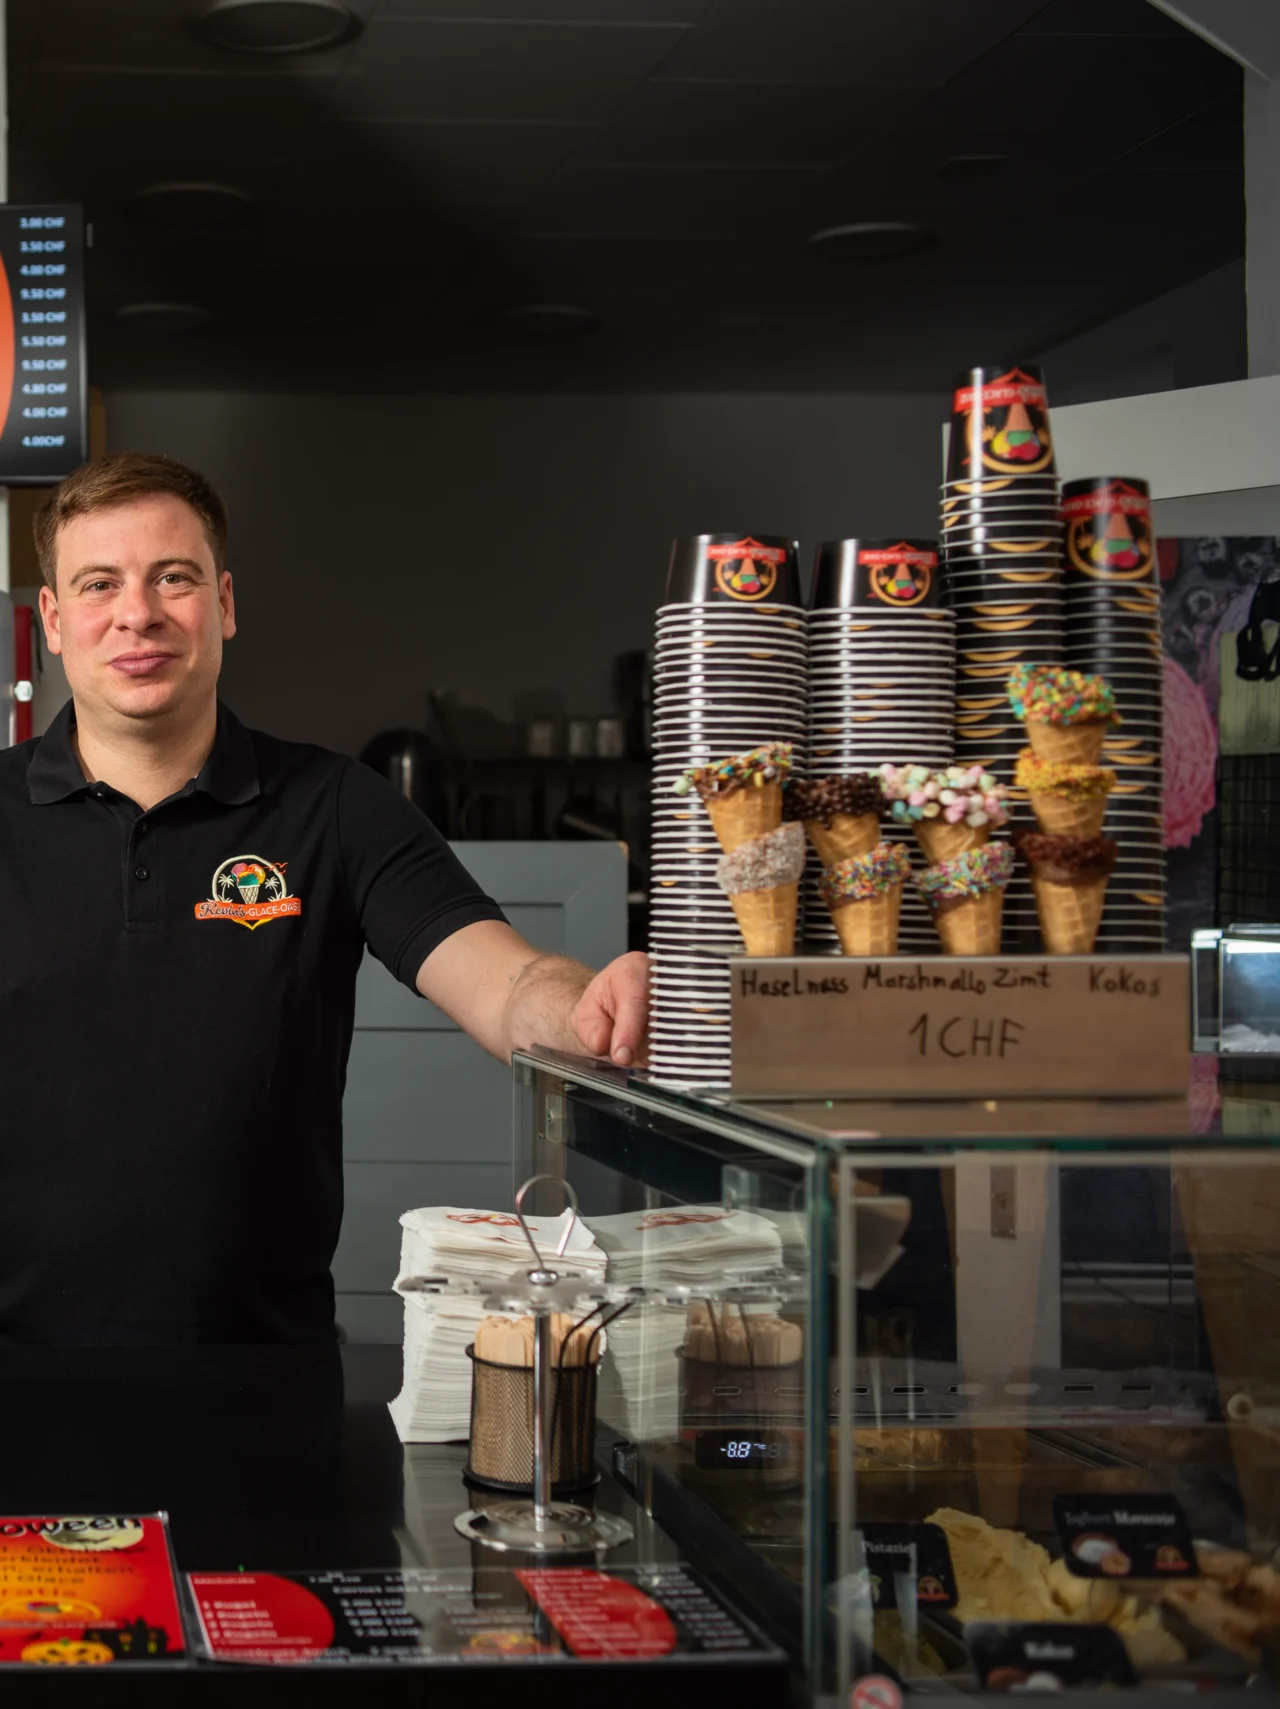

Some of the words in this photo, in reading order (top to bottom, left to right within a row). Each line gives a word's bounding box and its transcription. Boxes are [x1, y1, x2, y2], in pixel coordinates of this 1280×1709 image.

[44, 216, 66, 228] CHF
[44, 240, 66, 252] CHF
[45, 264, 66, 276] CHF
[45, 288, 66, 299] CHF
[46, 312, 66, 323] CHF
[46, 336, 67, 346] CHF
[46, 360, 67, 370] CHF
[46, 383, 68, 394] CHF
[47, 407, 68, 418] CHF
[993, 966, 1052, 990] Zimt
[1088, 965, 1162, 997] Kokos
